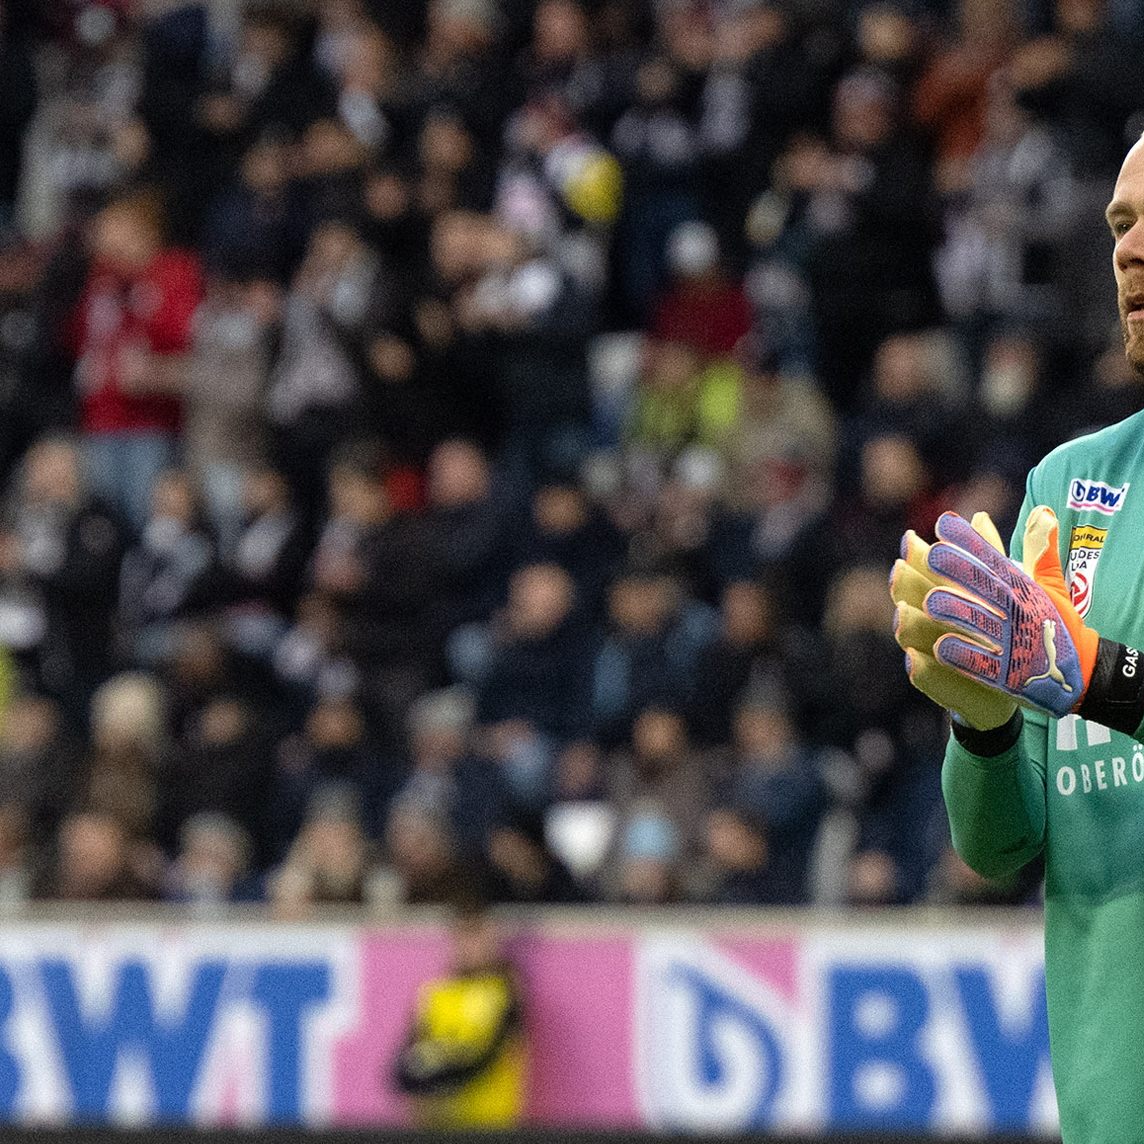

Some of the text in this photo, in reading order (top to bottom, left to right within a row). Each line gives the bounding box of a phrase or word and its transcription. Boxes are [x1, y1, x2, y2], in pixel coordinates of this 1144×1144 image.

[1086, 485, 1125, 508] BW
[1122, 645, 1141, 678] GAS
[0, 956, 332, 1123] WT
